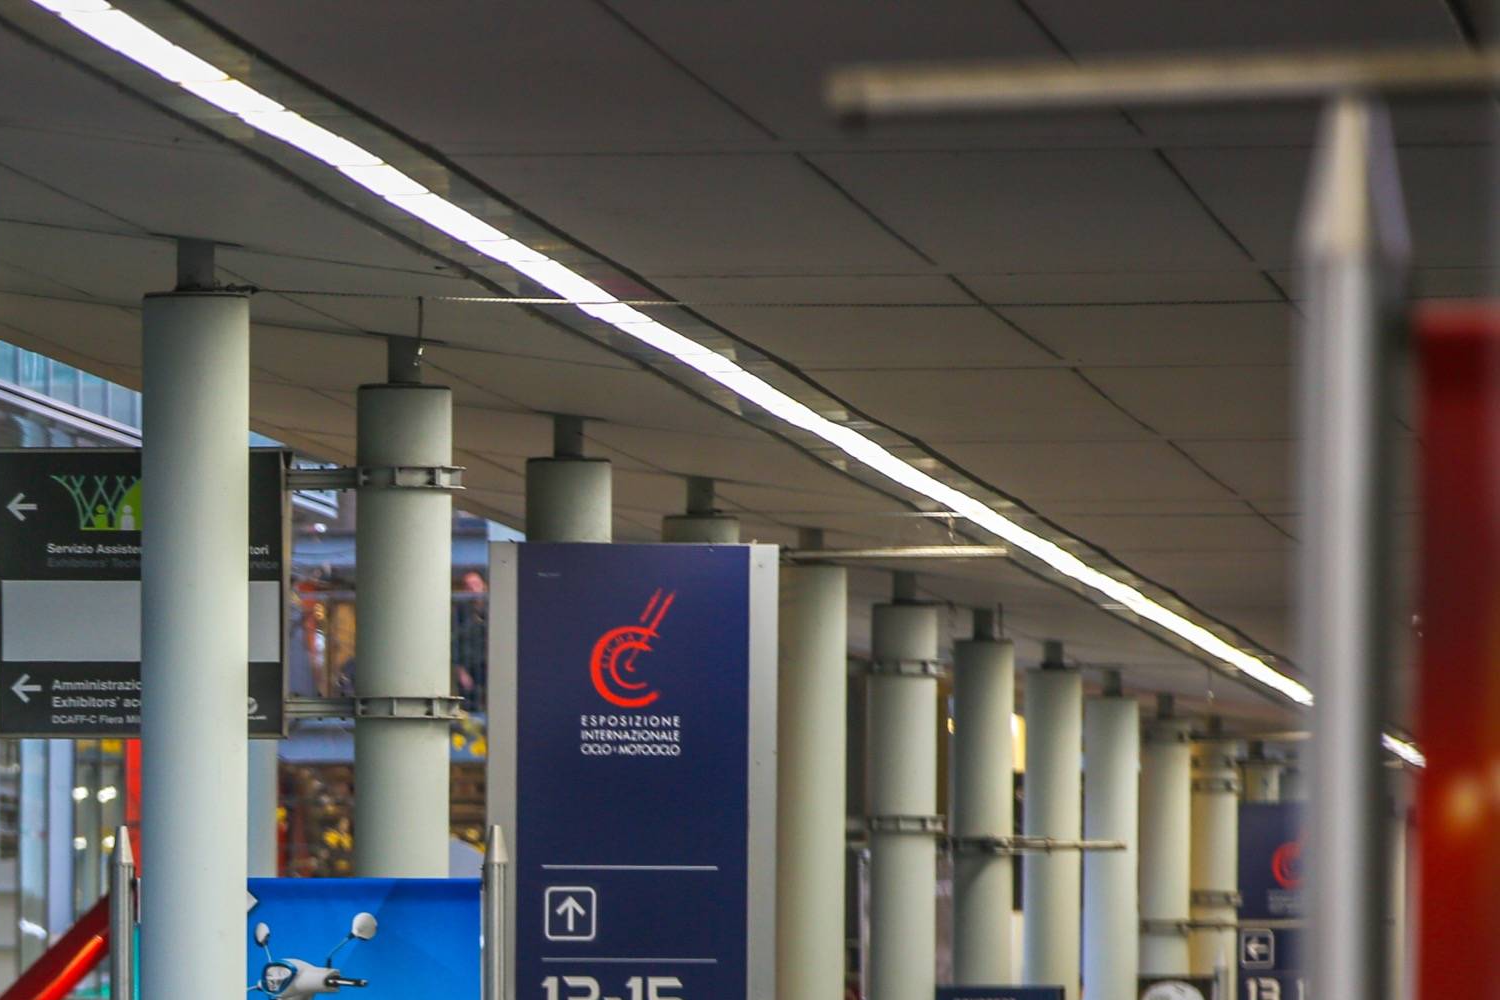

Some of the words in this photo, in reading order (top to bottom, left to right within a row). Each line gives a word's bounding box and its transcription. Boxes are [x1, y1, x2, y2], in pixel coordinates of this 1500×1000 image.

[46, 542, 94, 554] Servizio
[96, 543, 142, 554] Assiste
[51, 696, 121, 708] Exhibitors'
[123, 698, 142, 708] ac
[580, 714, 681, 728] ESPOSIZIONE
[580, 729, 681, 742] INTERNAZIONALE
[580, 743, 612, 756] CICLO
[618, 743, 682, 757] MOTOCICLO
